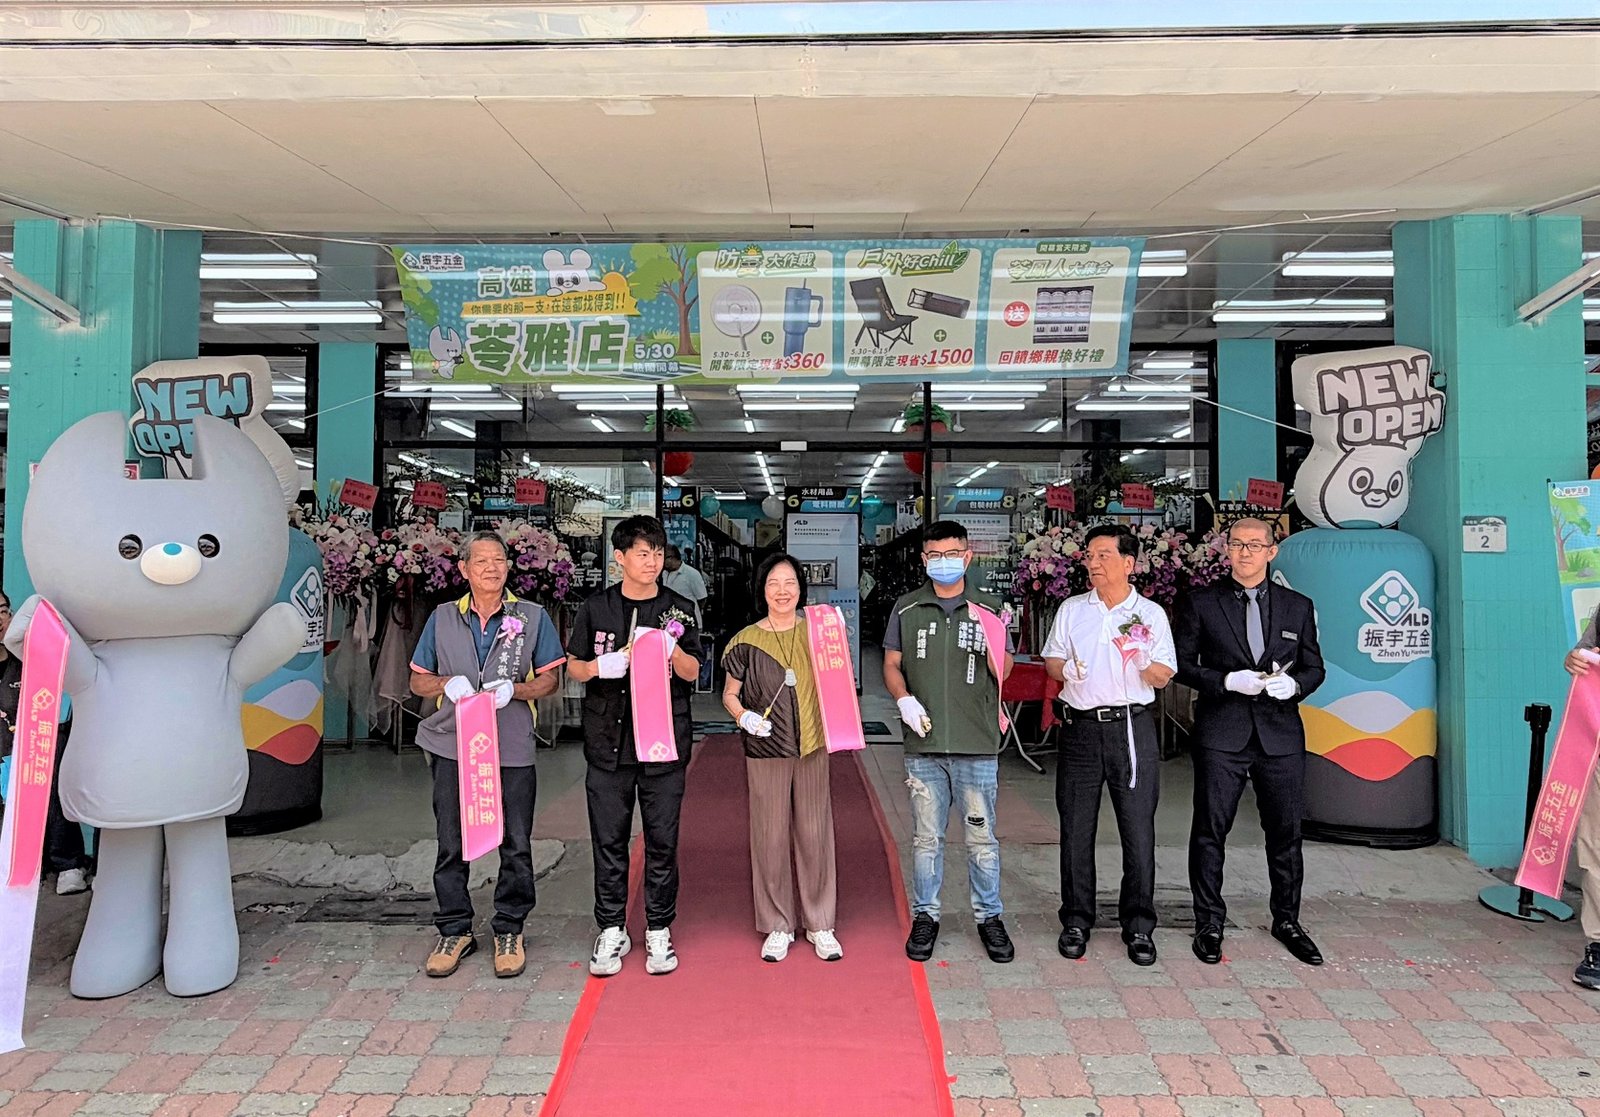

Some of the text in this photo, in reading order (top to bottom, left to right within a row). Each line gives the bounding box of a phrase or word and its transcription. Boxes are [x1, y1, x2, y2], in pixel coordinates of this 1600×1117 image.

[479, 267, 534, 294] 高雄
[1008, 306, 1025, 322] 送
[469, 321, 626, 373] 苓雅店
[634, 343, 675, 359] 5/30
[1321, 357, 1430, 412] NEW
[137, 376, 250, 421] NEW
[1342, 397, 1443, 443] OPEN
[801, 488, 834, 496] 水材用品
[682, 494, 695, 508] 6
[787, 494, 800, 508] 6
[847, 494, 859, 508] 7
[943, 494, 955, 507] 7
[1002, 495, 1015, 508] 8
[1481, 535, 1490, 549] 2
[1401, 613, 1430, 627] ALD
[1364, 628, 1431, 648] 振宇五金
[34, 720, 53, 786] 振宇五金
[478, 762, 496, 825] 振宇五金
[1537, 780, 1567, 839] 振宇五金
